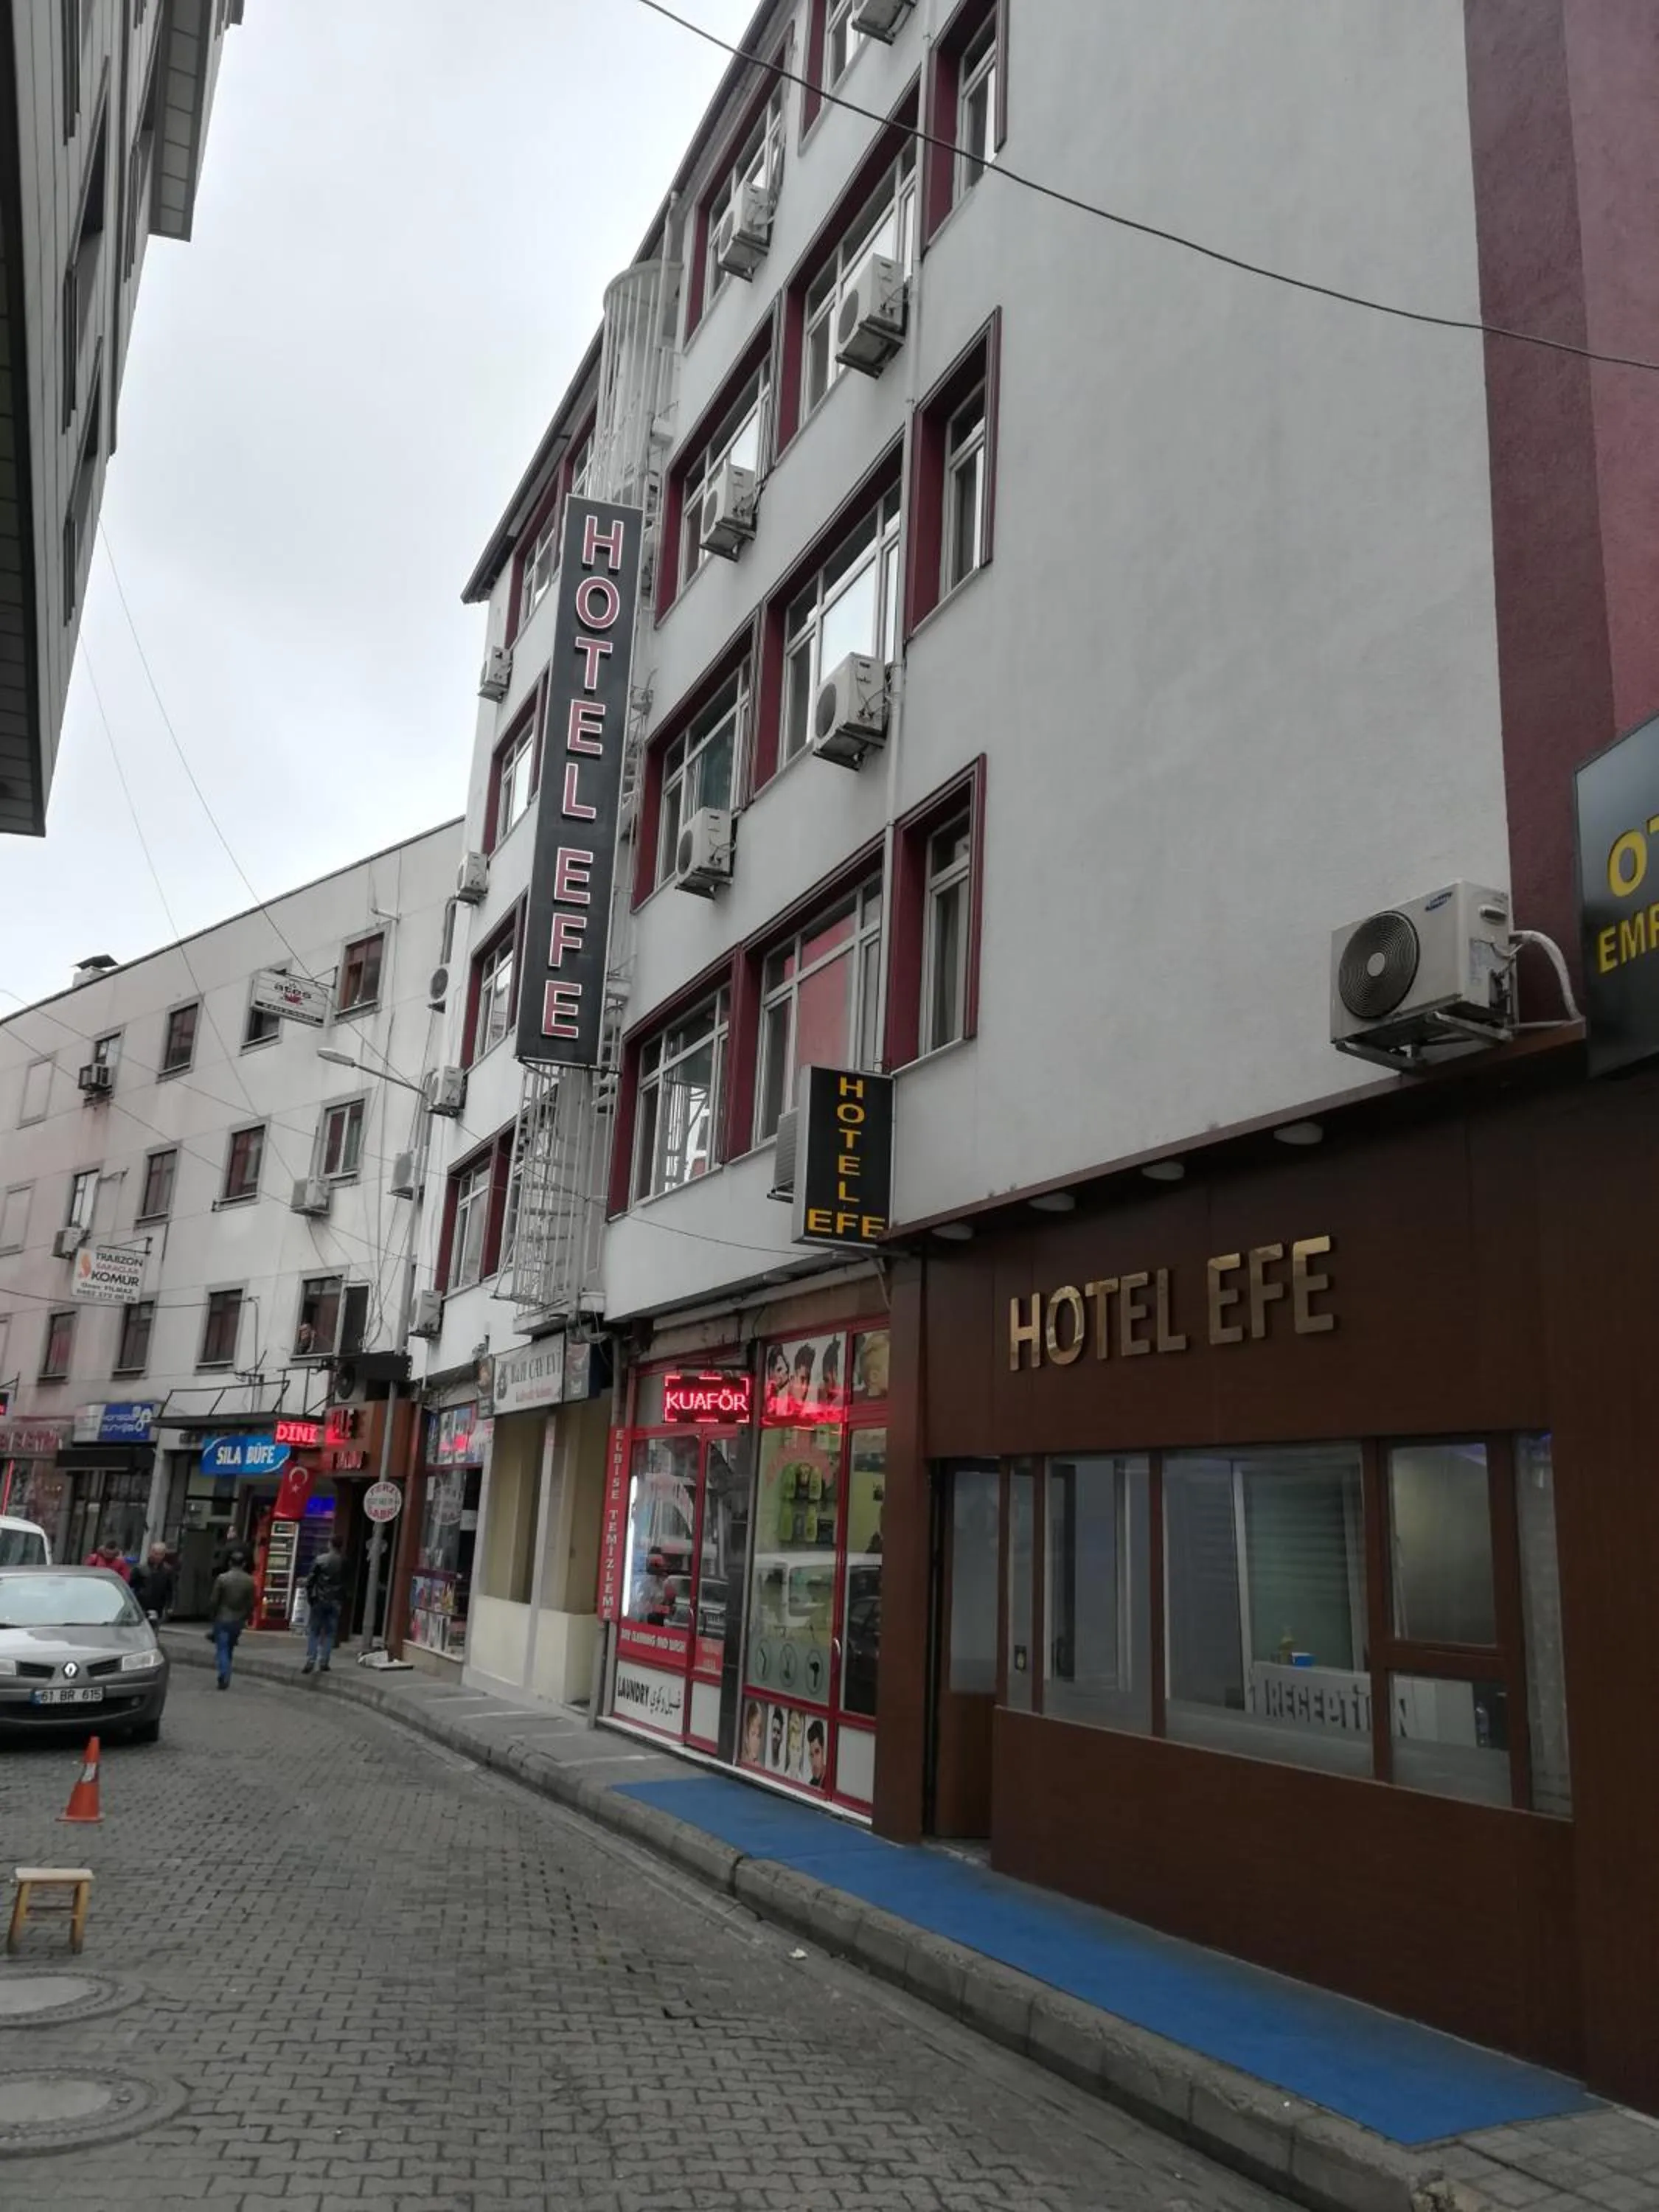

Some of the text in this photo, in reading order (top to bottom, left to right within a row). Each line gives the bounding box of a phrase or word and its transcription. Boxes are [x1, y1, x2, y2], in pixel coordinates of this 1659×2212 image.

[540, 514, 624, 1040] HOTEL EFE
[836, 1076, 866, 1203] HOTEL
[808, 1208, 886, 1238] EFE
[96, 1252, 143, 1267] TRABZON
[1009, 1235, 1335, 1371] HOTEL EFE
[666, 1389, 748, 1411] KUAFÖR
[617, 1675, 650, 1707] LAUNDRY
[1264, 1678, 1407, 1739] RECEPTIN
